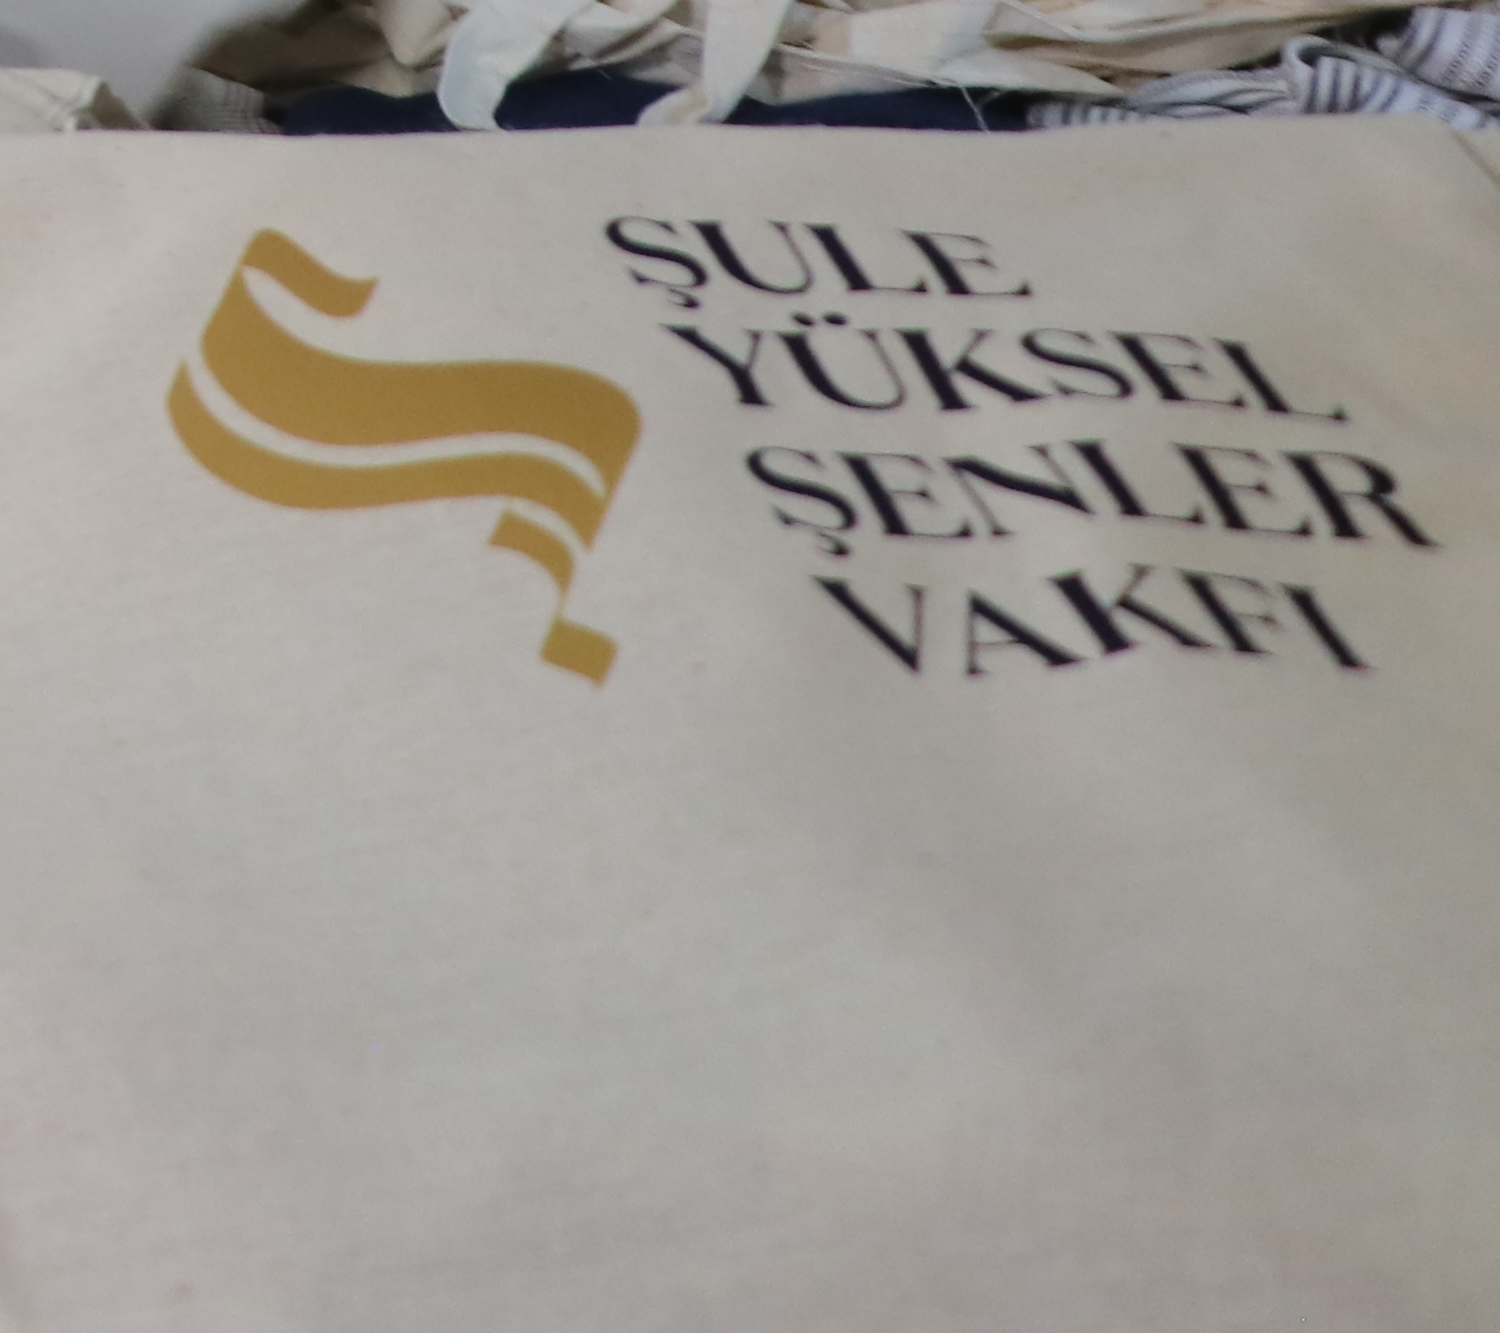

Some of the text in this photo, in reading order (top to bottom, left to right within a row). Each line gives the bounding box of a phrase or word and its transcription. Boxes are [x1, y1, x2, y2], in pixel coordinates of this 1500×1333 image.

[606, 216, 1033, 309] ŞULE
[660, 311, 1350, 423] YÜKSEL
[744, 440, 1444, 558] ŞENLER
[813, 562, 1377, 676] VAKFI
